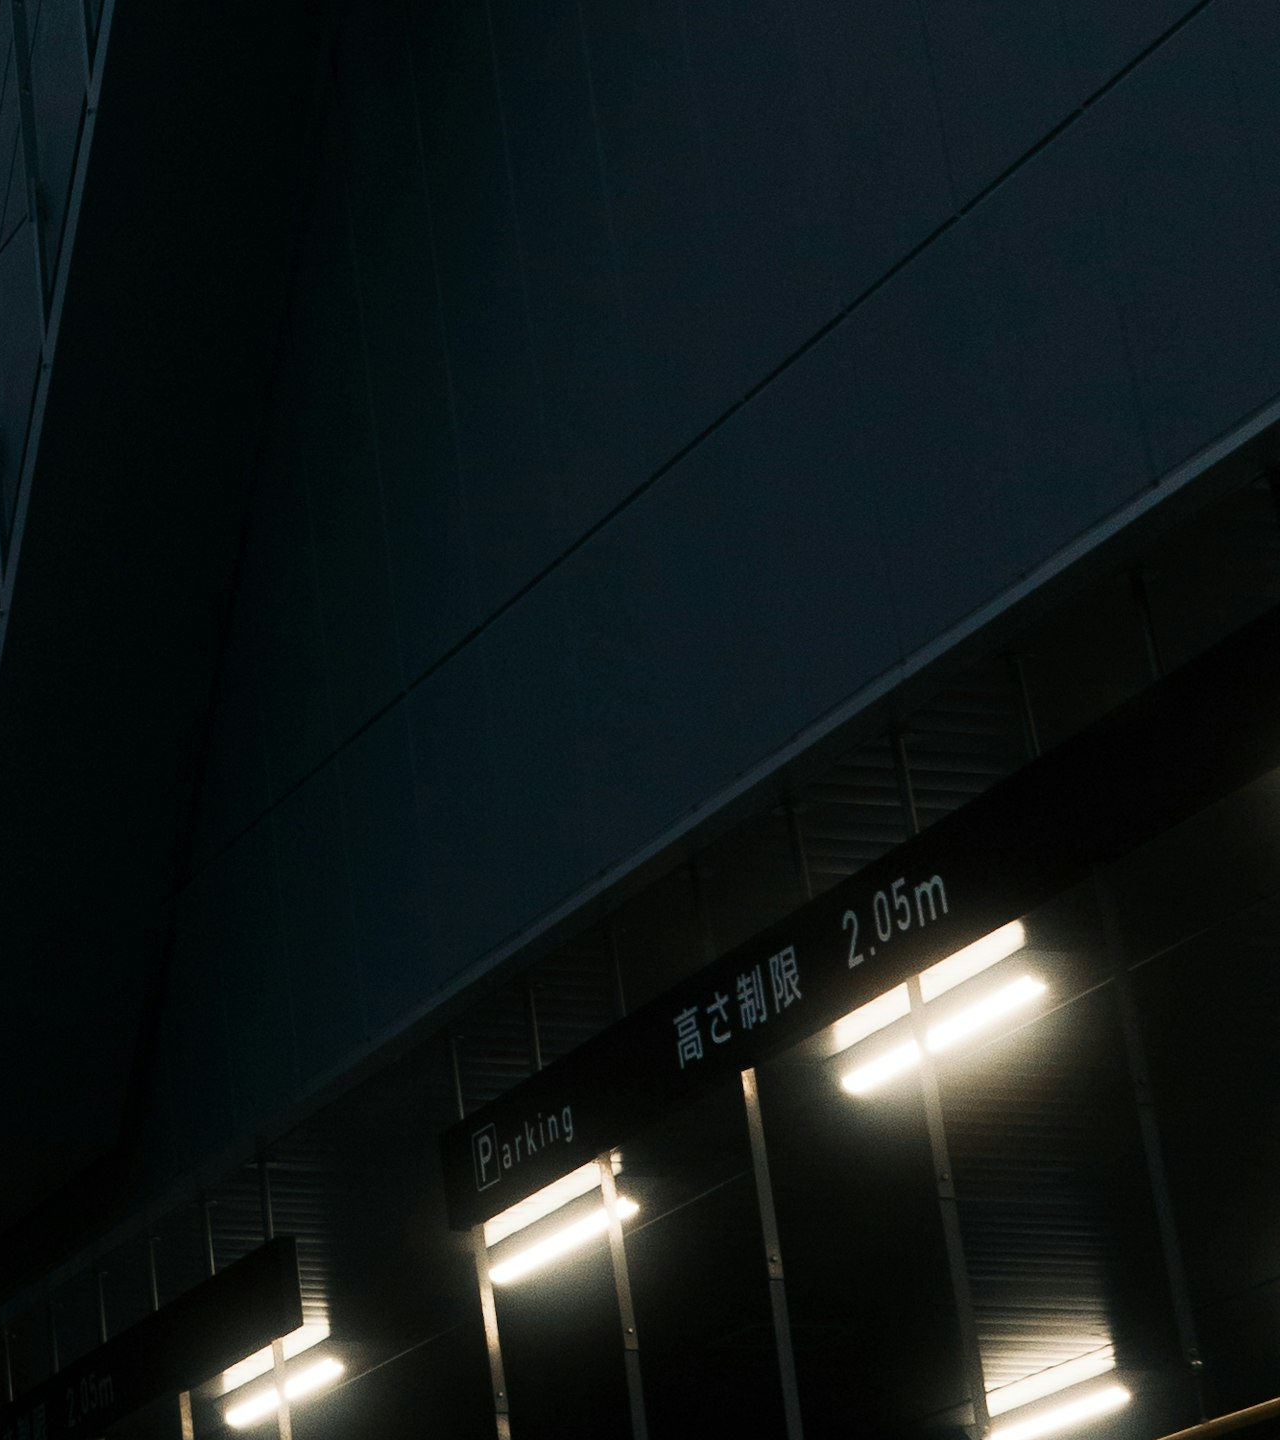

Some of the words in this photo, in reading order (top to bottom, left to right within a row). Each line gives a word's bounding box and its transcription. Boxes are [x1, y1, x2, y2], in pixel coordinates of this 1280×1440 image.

[672, 944, 804, 1070] 高さ制限
[841, 873, 949, 970] 2.05m
[474, 1104, 575, 1186] Parking
